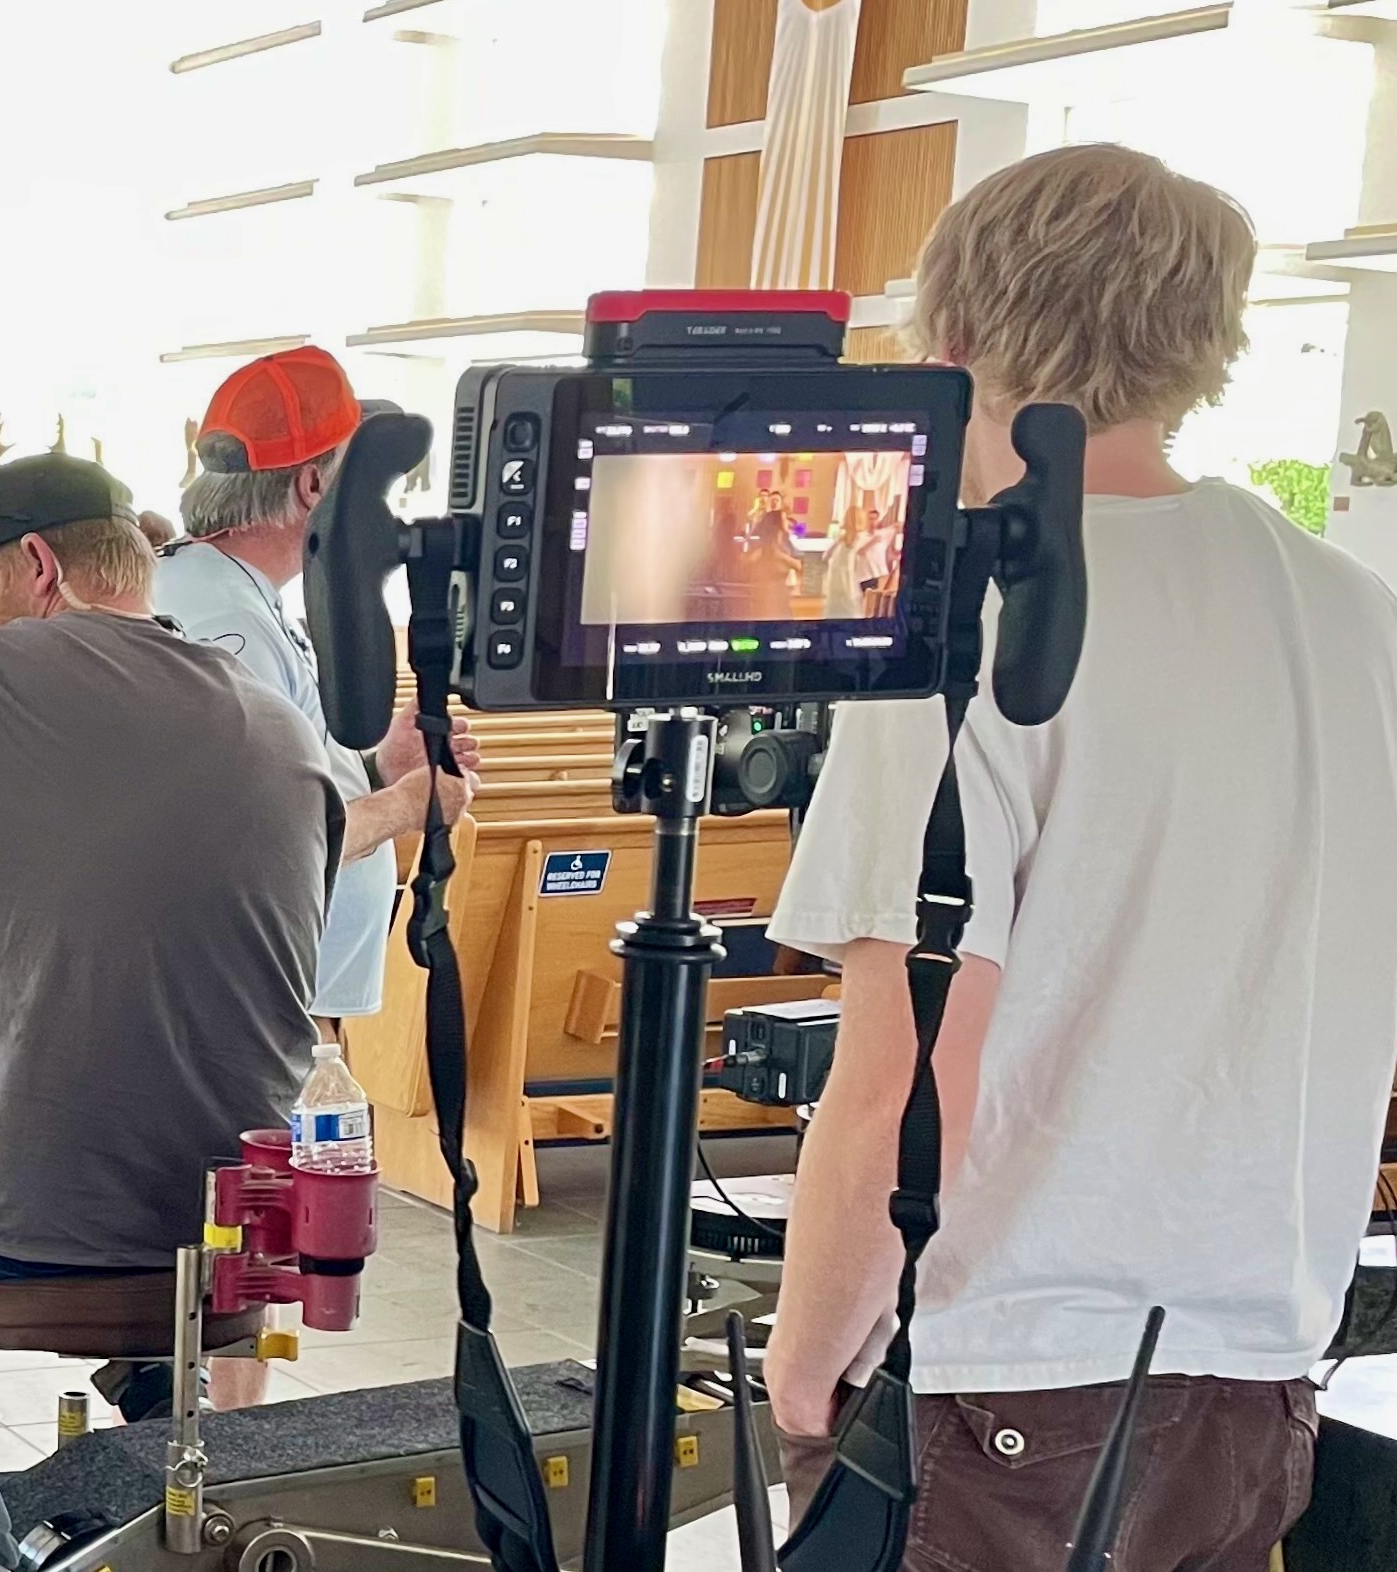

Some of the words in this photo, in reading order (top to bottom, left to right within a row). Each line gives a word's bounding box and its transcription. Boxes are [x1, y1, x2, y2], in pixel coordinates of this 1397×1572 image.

[507, 515, 522, 527] F1
[503, 557, 518, 569] F2
[496, 643, 512, 655] F4
[706, 671, 763, 683] SMALLHD
